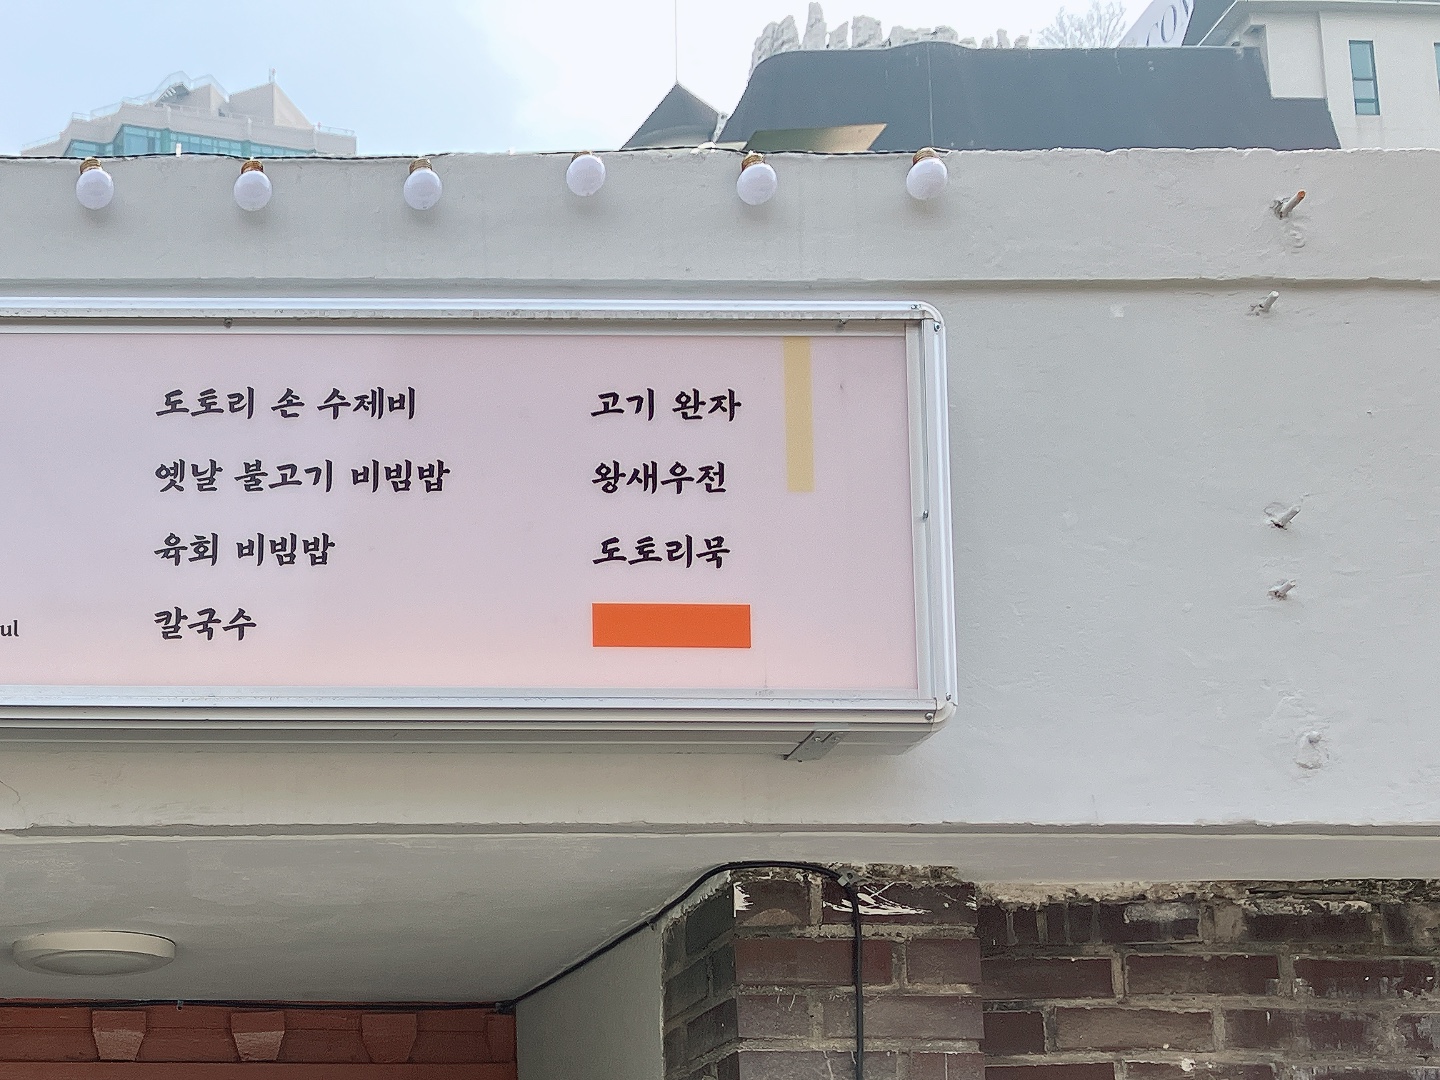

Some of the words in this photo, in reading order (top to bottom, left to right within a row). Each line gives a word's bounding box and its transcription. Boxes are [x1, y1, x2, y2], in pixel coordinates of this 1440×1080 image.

[155, 386, 255, 420] 도토리
[270, 387, 306, 419] 손
[316, 386, 416, 421] 수제비
[590, 387, 655, 422] 고기
[671, 387, 743, 423] 완자
[154, 458, 224, 493] 옛날
[233, 458, 333, 493] 불고기
[350, 458, 451, 494] 비빔밥
[591, 459, 727, 495] 왕새우전
[153, 532, 219, 567] 육회
[235, 532, 336, 567] 비빔밥
[591, 533, 731, 570] 도토리묵
[153, 605, 258, 642] 칼국수
